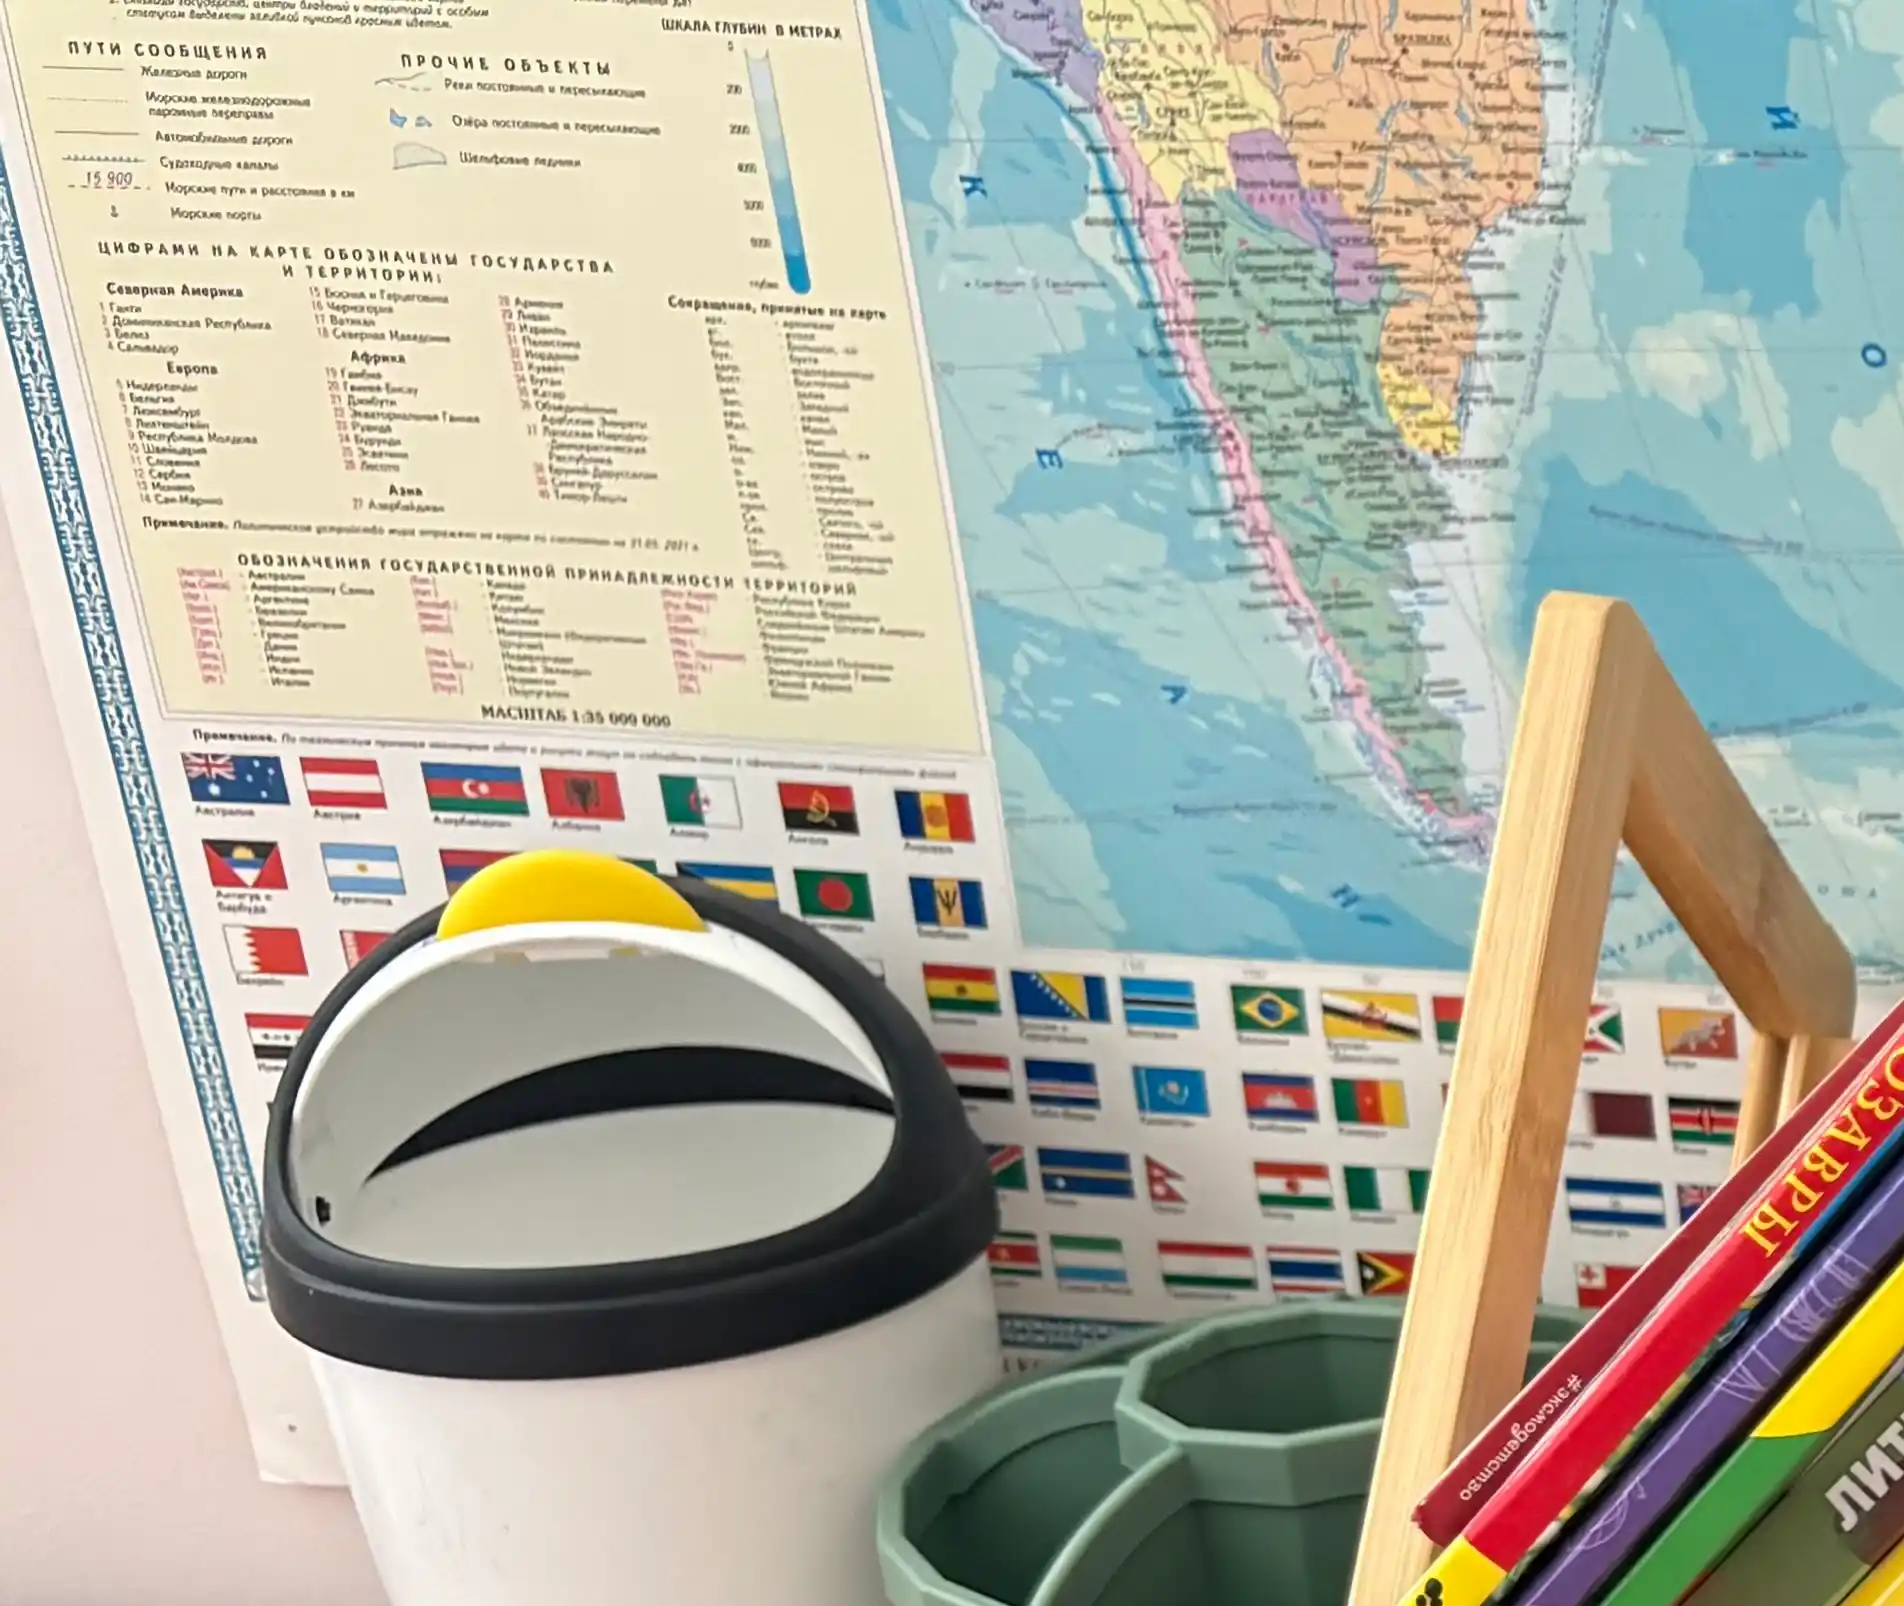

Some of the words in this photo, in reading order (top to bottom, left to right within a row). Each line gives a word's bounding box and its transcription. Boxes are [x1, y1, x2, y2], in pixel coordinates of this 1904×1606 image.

[662, 17, 711, 32] ШКАЛА
[715, 21, 767, 36] ГЛУБИН
[776, 24, 784, 36] В
[789, 25, 842, 40] МЕТРАХ
[68, 40, 122, 56] ПУТИ
[135, 42, 267, 61] СООБЩЕНИЯ
[400, 54, 490, 70] ПРОЧИЕ
[504, 57, 611, 76] ОБЪЕКТЫ
[98, 241, 200, 258] ЦИФРАМИ
[212, 245, 238, 258] НА
[249, 246, 312, 260] КАРТЕ
[324, 247, 458, 267] ОБОЗНАЧЕНЫ
[470, 254, 614, 274] ГОСУДАРСТВА
[282, 264, 294, 278] И
[306, 264, 442, 284] ТЕРРИТОРИИ:
[106, 282, 175, 299] Северная
[181, 283, 244, 299] Америка
[668, 294, 757, 314] Сокращения,
[350, 350, 406, 366] Африка
[167, 361, 218, 376] Европа
[388, 484, 423, 497] Азия
[238, 553, 371, 570] ОБОЗНАЧЕНИЯ
[381, 557, 556, 579] ГОСУДАРСТВЕННОЙ
[565, 566, 735, 590] ПРИНАДЛЕЖНОСТИ
[744, 577, 858, 597] ТЕРРИТОРИЙ
[481, 704, 567, 722] МАСШТАБ
[1458, 1373, 1583, 1503] #эксмодетство
